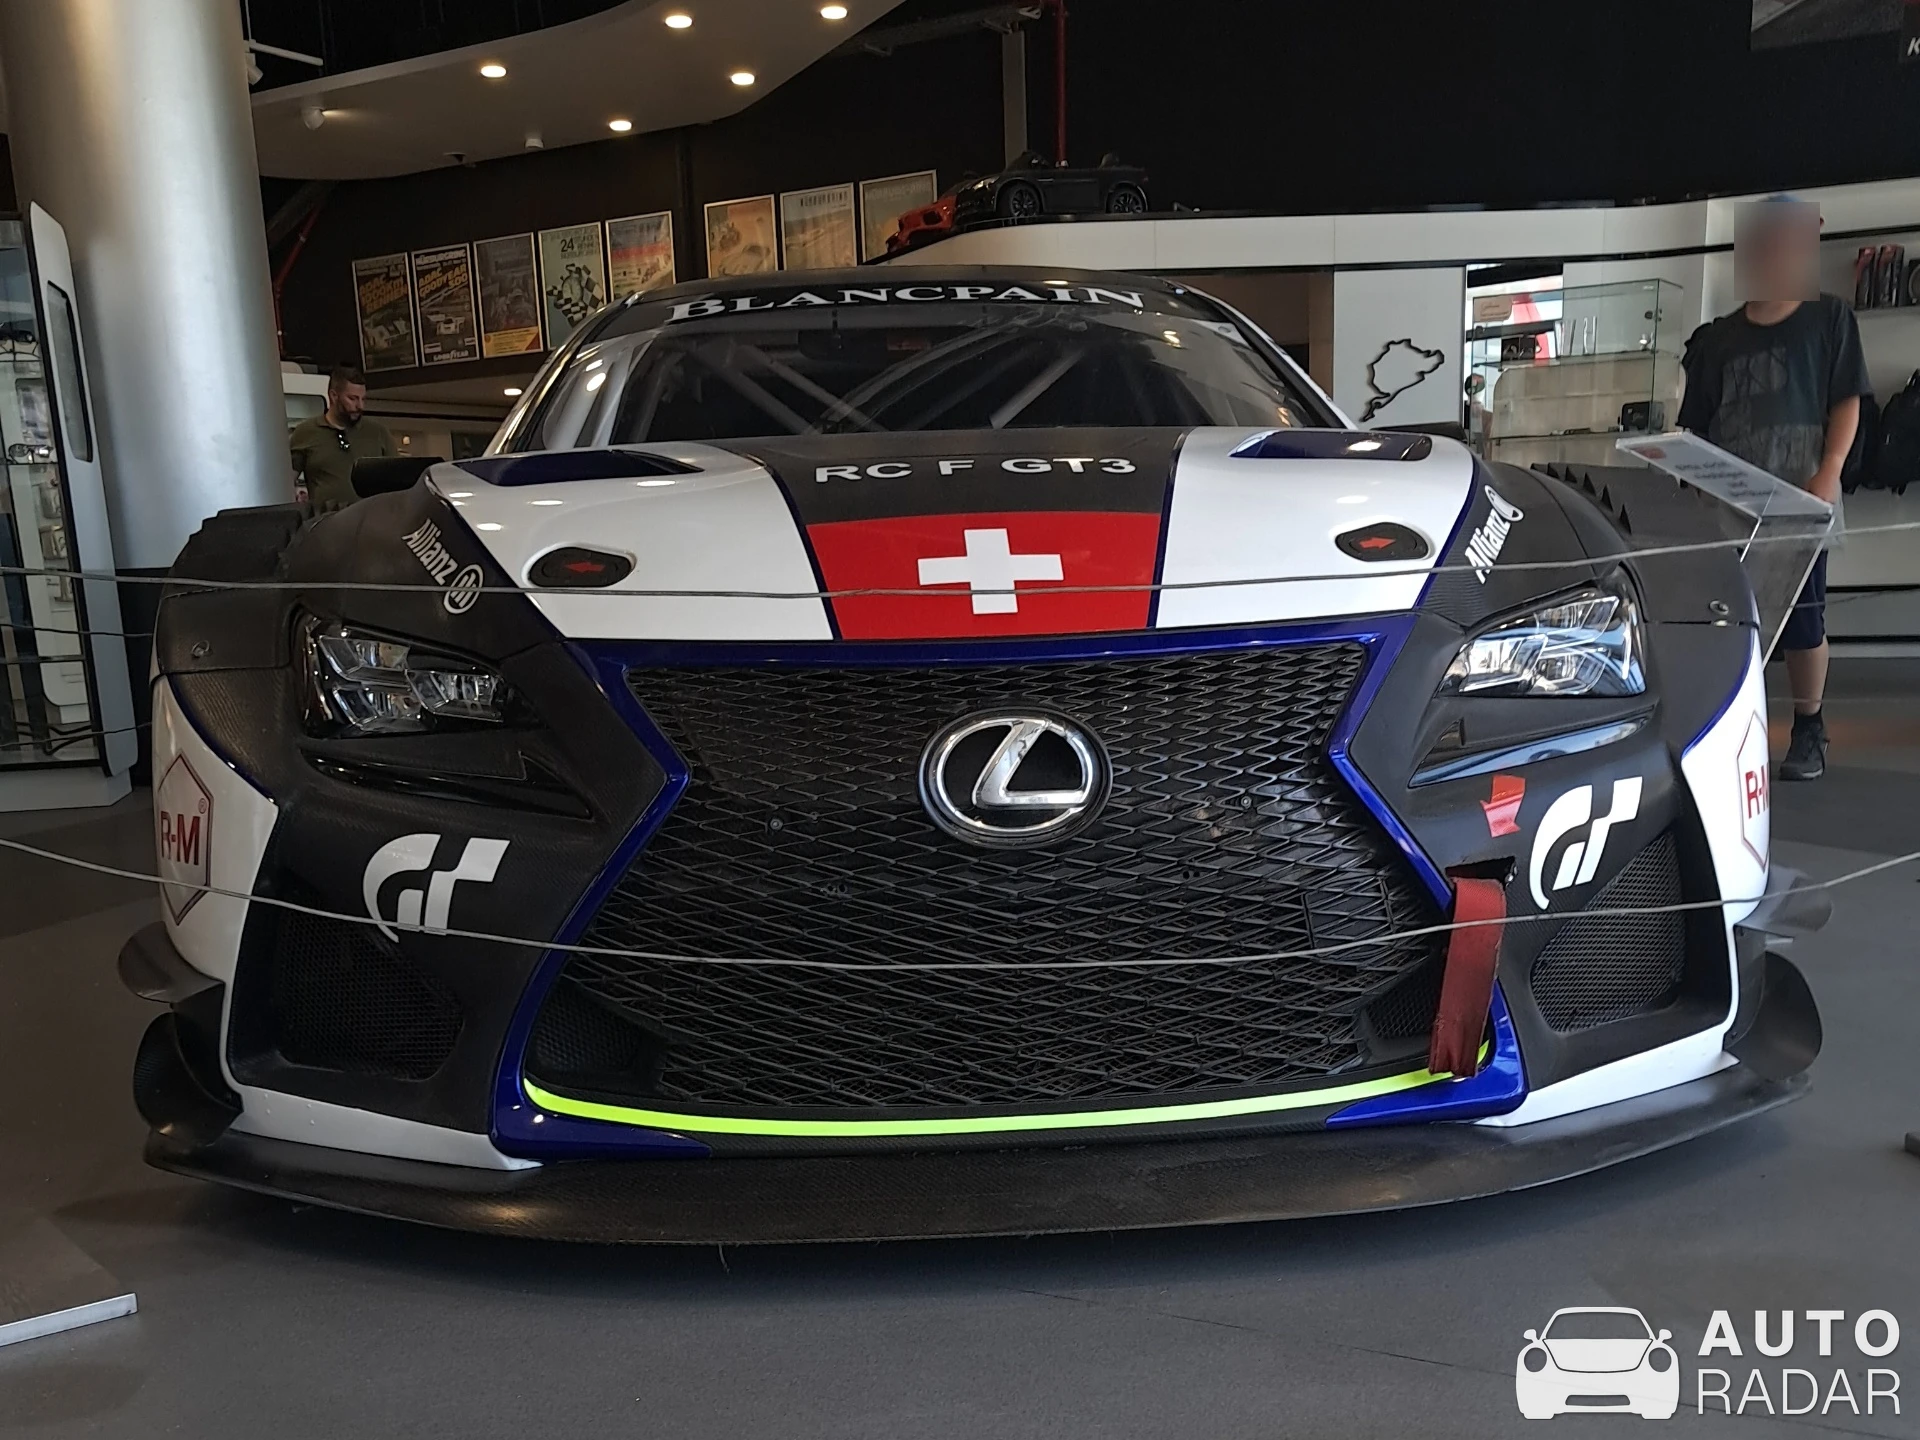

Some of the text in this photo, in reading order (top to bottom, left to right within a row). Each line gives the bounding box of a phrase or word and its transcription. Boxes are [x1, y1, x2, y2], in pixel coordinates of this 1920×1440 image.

[560, 236, 574, 253] 24
[663, 286, 1145, 325] BLANCPAIN
[815, 457, 1137, 483] RC F GT3
[401, 518, 459, 586] Allianz
[1464, 508, 1512, 585] Allianz
